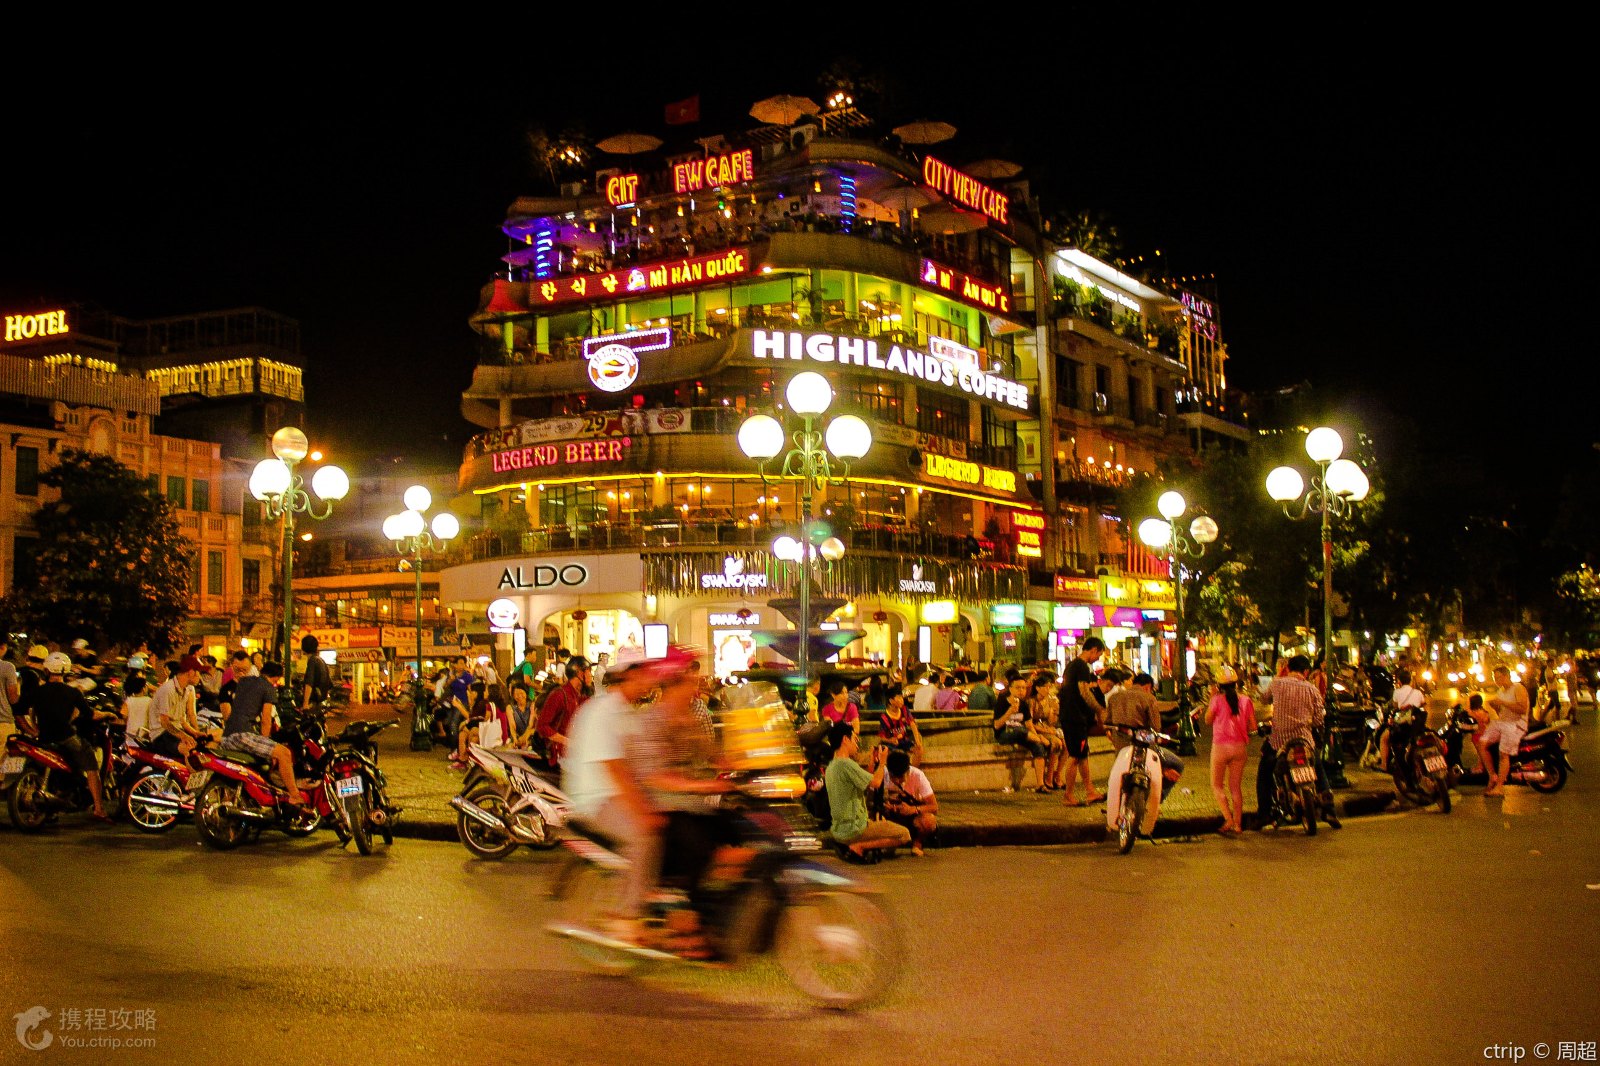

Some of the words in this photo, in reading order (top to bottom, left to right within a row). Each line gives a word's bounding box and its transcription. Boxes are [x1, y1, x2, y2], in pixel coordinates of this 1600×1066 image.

[705, 149, 753, 187] CAFE
[923, 155, 952, 195] CITY
[953, 169, 981, 210] VIEW
[982, 186, 1008, 224] CAFE
[650, 265, 667, 288] MÌ
[671, 260, 701, 284] HÀN
[4, 310, 69, 341] HOTEL
[752, 329, 955, 387] HIGHLANDS
[957, 367, 1028, 410] COFFEE
[493, 445, 558, 473] LEGEND
[565, 440, 624, 464] BEER
[497, 564, 587, 590] ALDO
[702, 573, 767, 588] SWAROVSKI
[900, 579, 936, 594] SWAROVSKI
